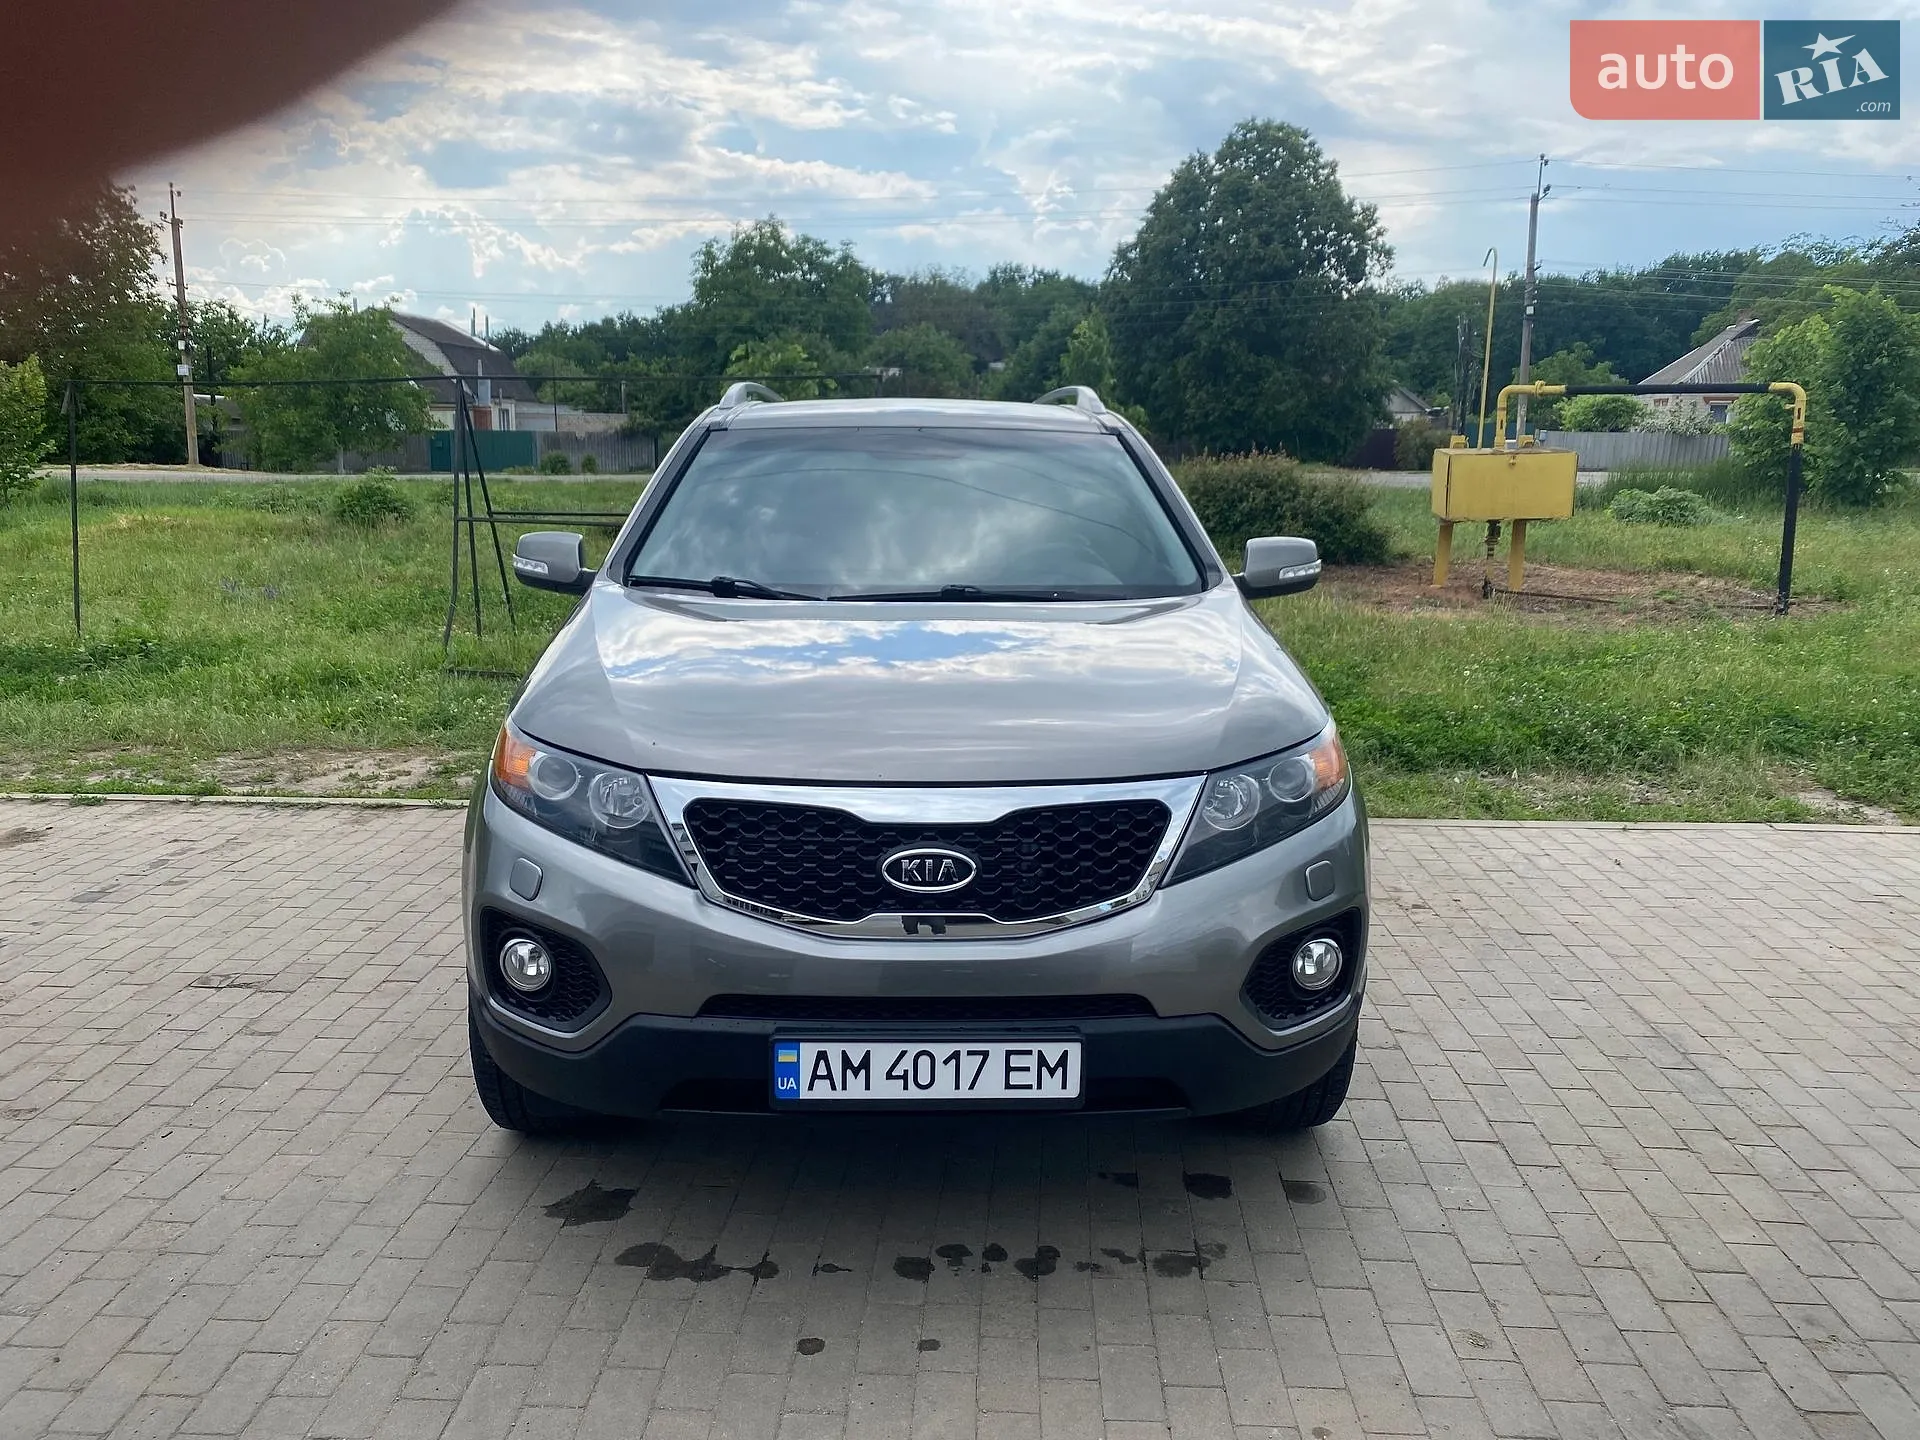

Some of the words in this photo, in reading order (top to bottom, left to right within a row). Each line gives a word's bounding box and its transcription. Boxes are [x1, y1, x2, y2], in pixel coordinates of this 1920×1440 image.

[901, 859, 959, 882] KIA
[807, 1049, 871, 1091] AM
[885, 1049, 990, 1091] 4017
[1004, 1049, 1069, 1090] EM
[778, 1077, 797, 1090] UA
